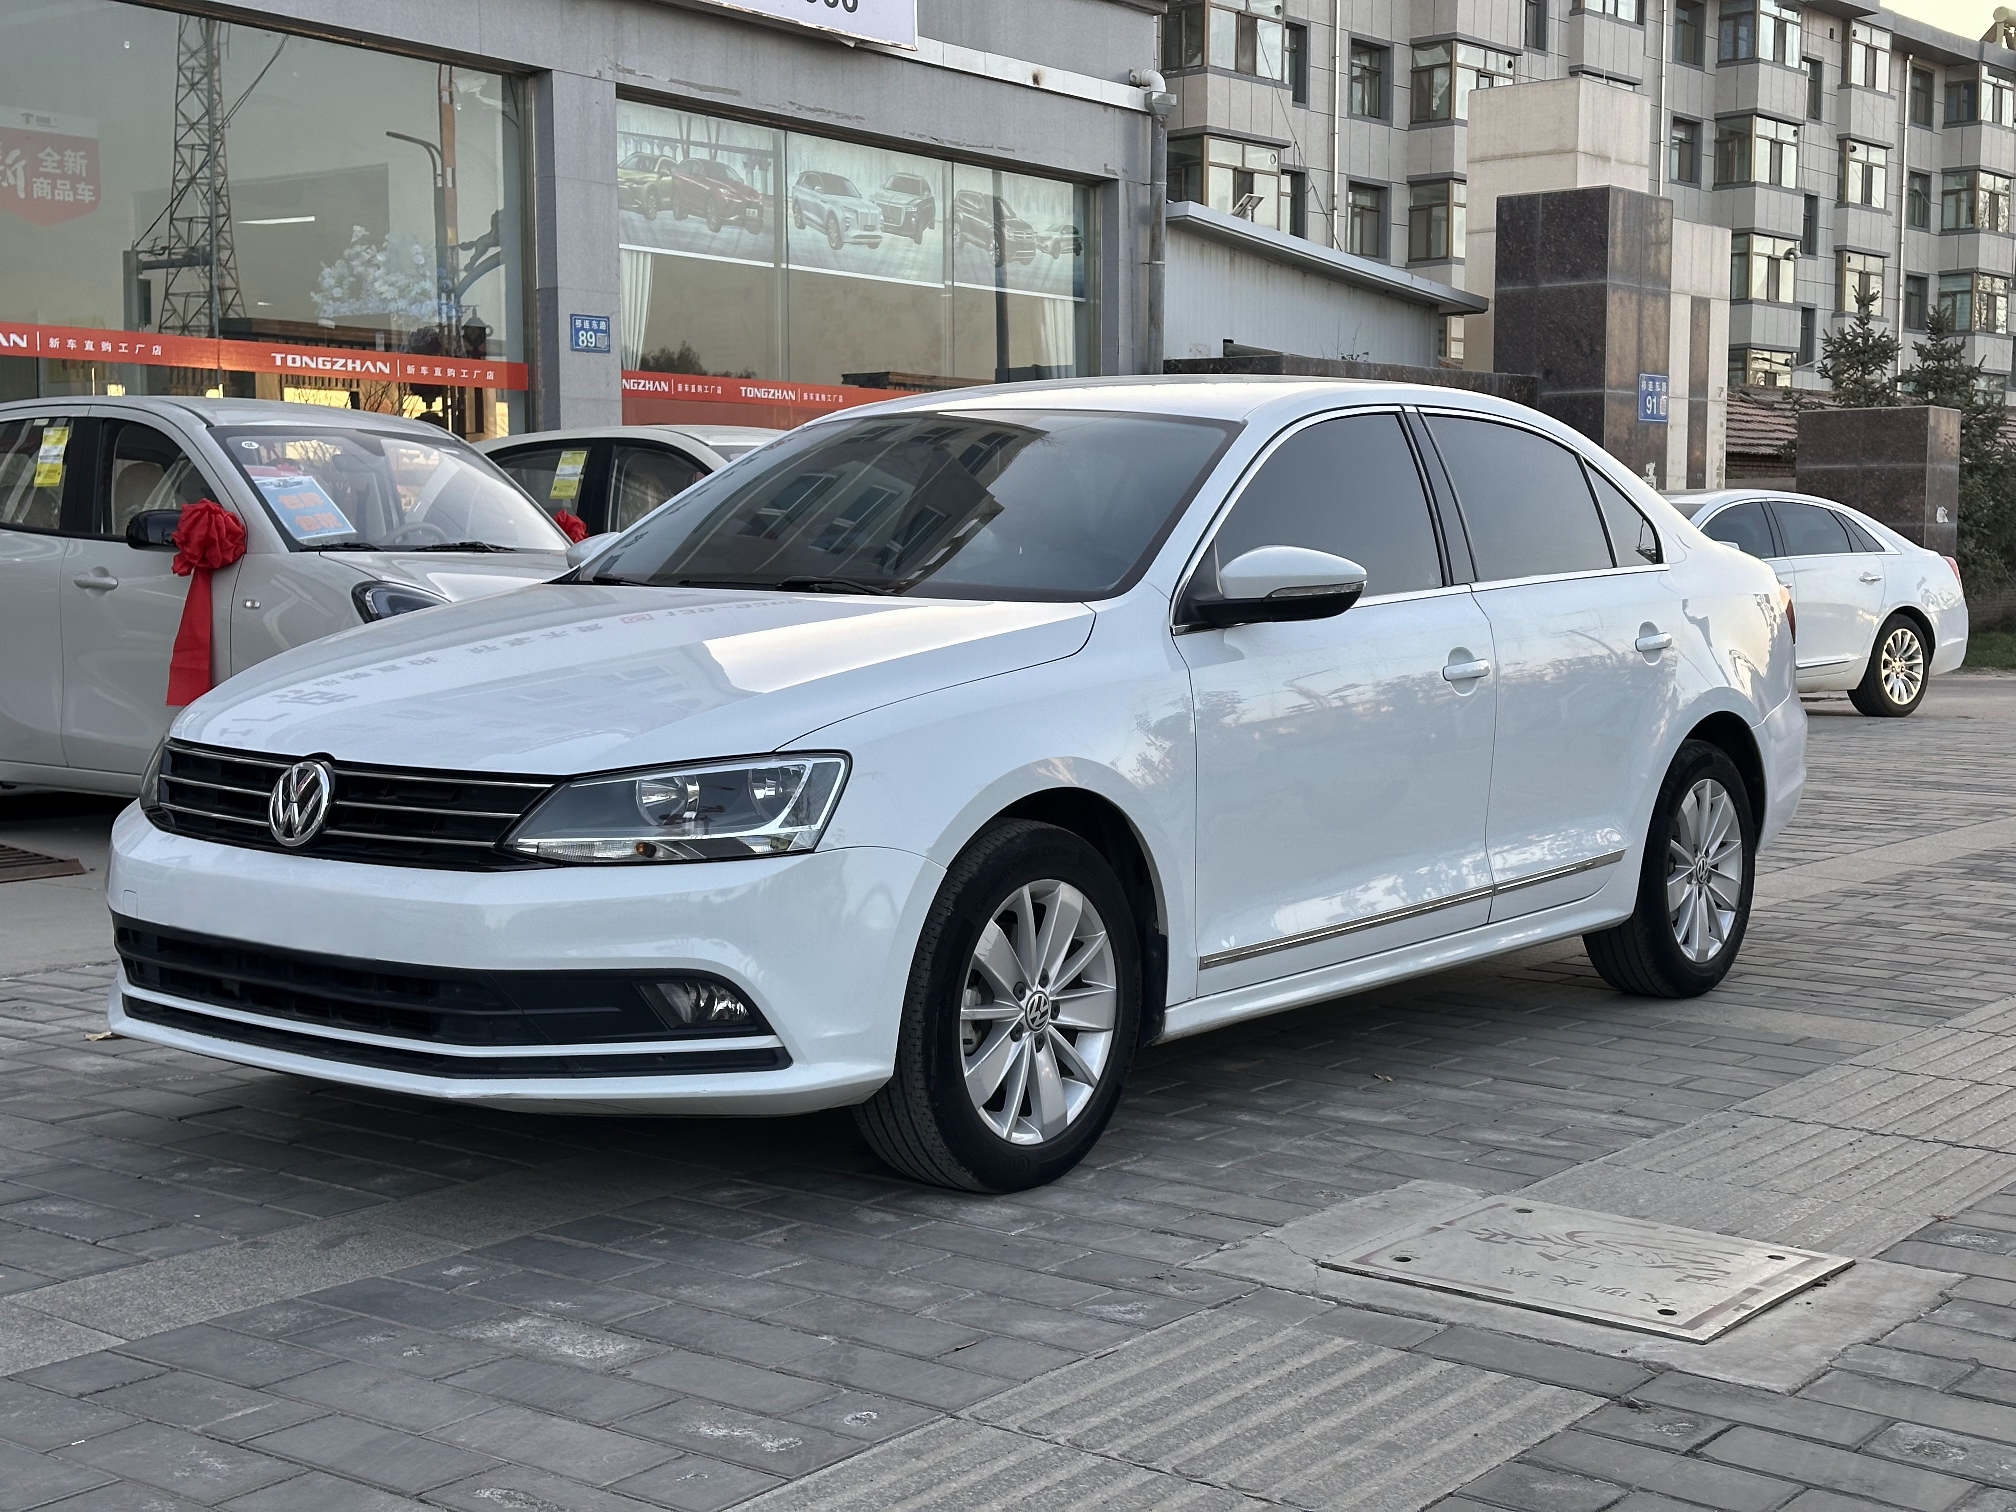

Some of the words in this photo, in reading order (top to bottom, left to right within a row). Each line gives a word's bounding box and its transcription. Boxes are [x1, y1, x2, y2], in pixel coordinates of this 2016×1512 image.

[37, 146, 88, 177] 全新
[32, 177, 96, 203] 商品车
[48, 336, 163, 357] 新车直购工厂店
[578, 330, 596, 348] 89
[271, 352, 391, 375] TONGZHAN
[406, 364, 495, 381] 新车直购工厂店
[622, 378, 669, 392] NGZHAN
[740, 386, 796, 401] TONGZHAN
[1646, 395, 1657, 415] 91
